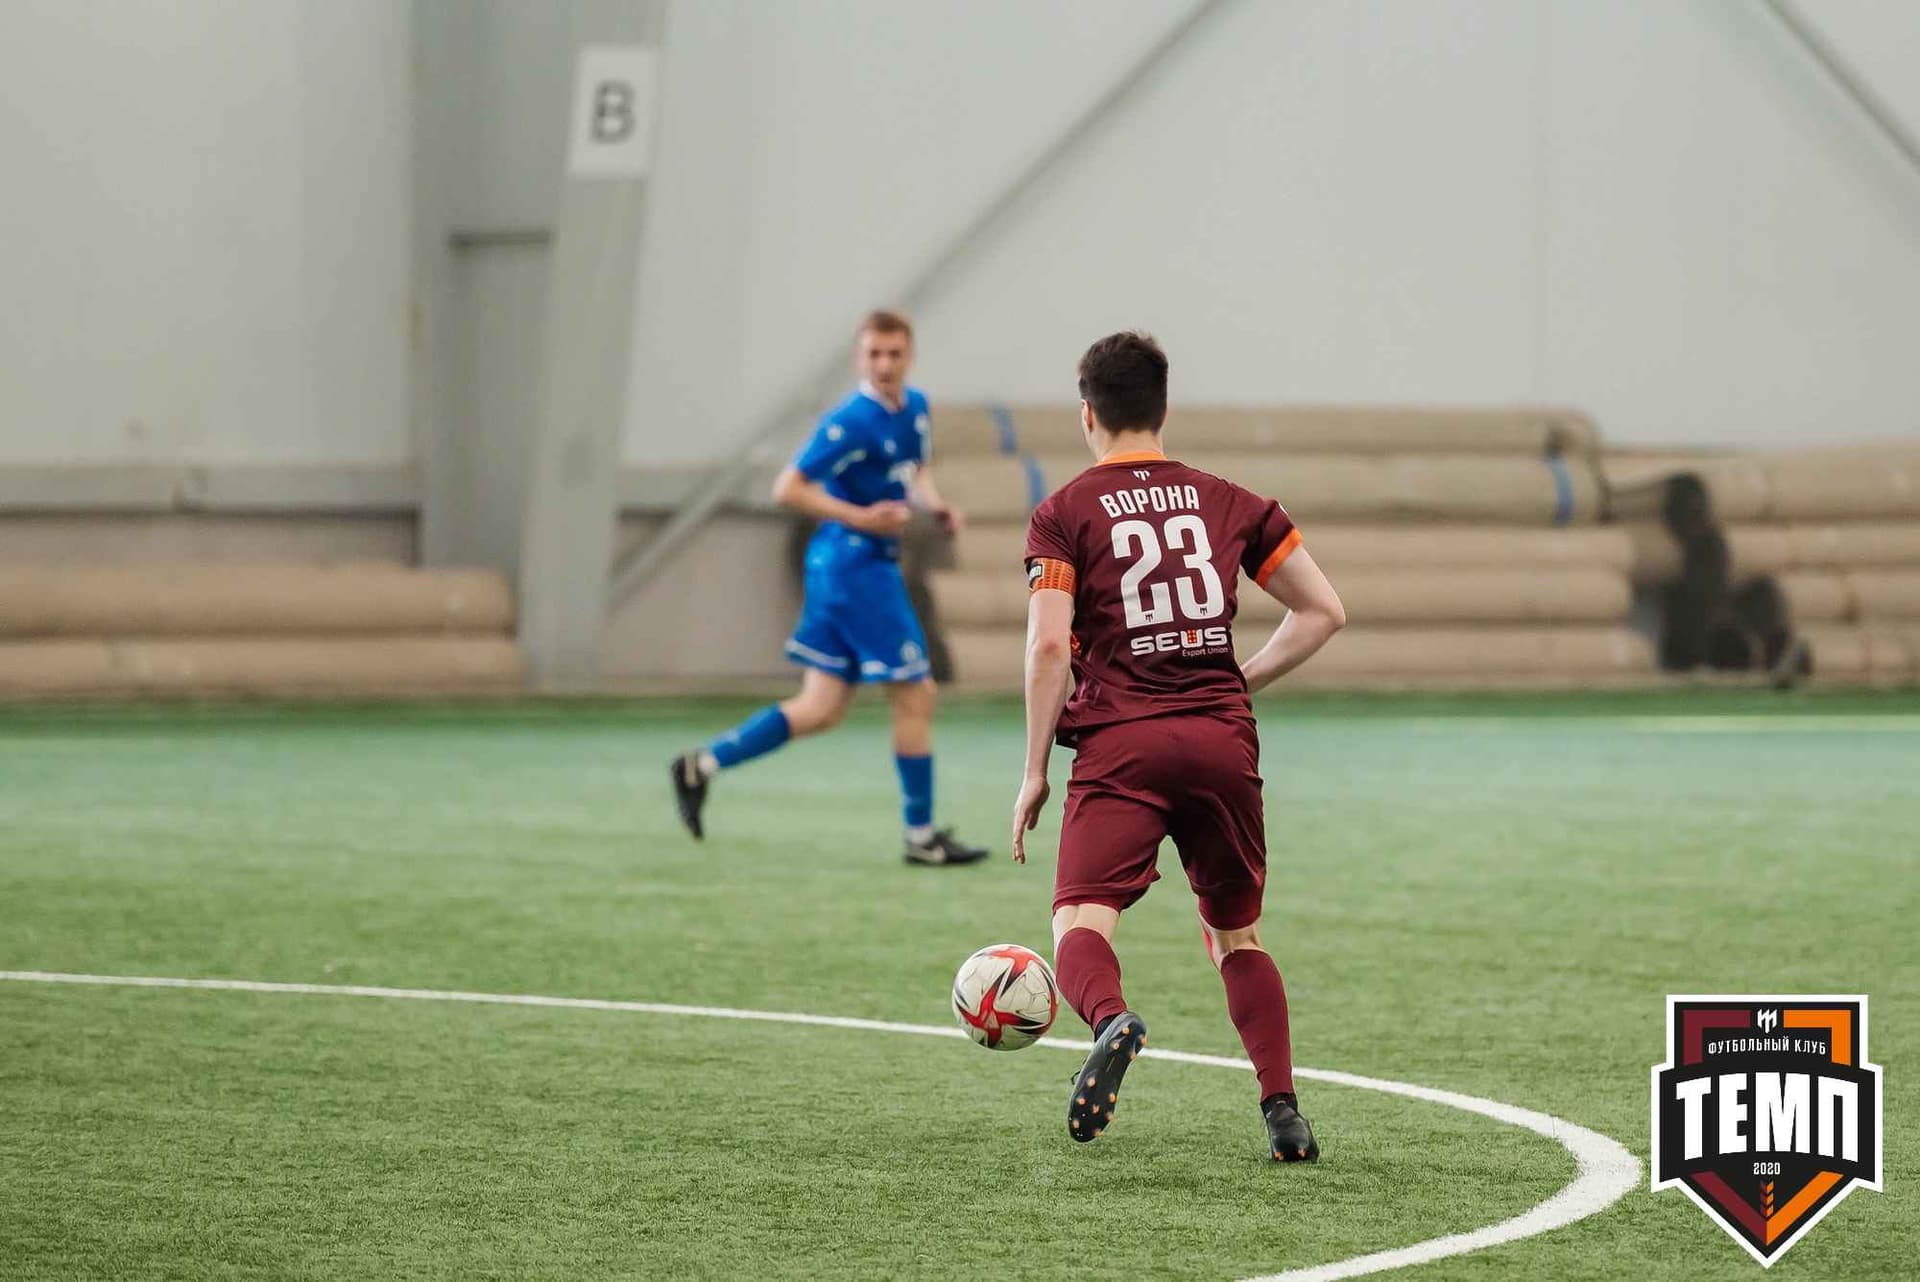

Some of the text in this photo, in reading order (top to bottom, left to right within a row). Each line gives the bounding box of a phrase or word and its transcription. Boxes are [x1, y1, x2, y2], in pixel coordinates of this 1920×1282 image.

[1099, 485, 1200, 518] ВОРОНА
[1110, 514, 1224, 629] 23
[1130, 626, 1228, 656] SEUS
[1182, 646, 1229, 657] Export Union
